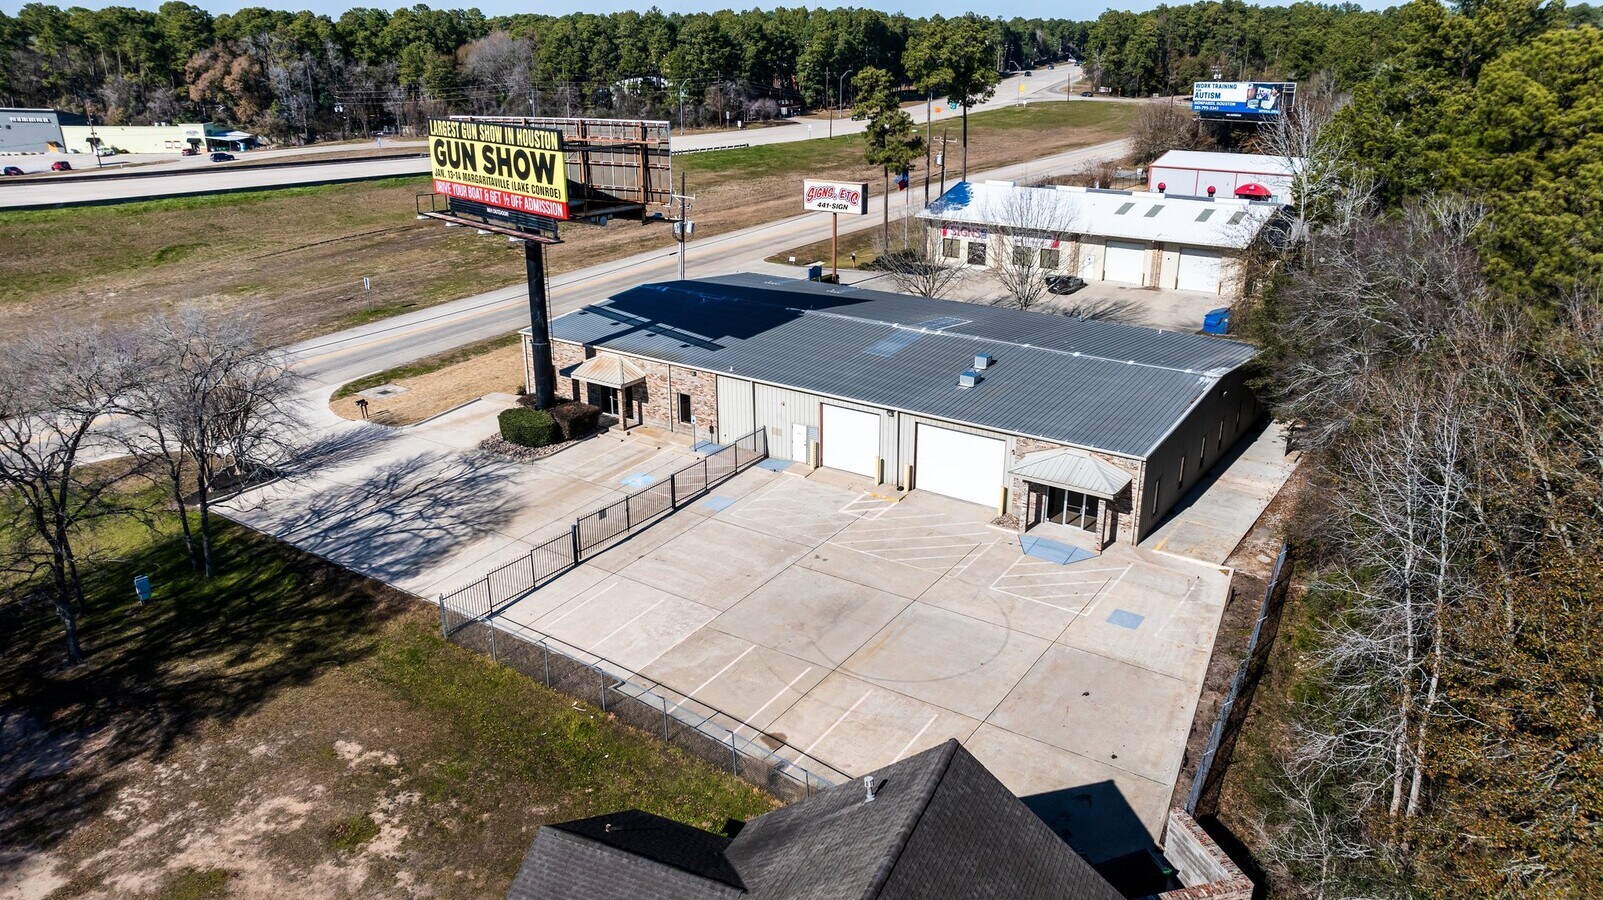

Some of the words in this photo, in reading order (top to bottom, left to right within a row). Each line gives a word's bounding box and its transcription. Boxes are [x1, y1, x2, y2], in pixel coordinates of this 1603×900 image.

[429, 120, 459, 138] LARGEST
[461, 122, 477, 140] GUN
[479, 124, 502, 143] SHOW
[504, 126, 515, 145] IN
[516, 128, 559, 150] HOUSTON
[433, 138, 477, 172] GUN
[482, 144, 556, 185] SHOW
[435, 168, 446, 178] JAN.
[448, 170, 461, 180] 13-14
[462, 172, 510, 189] MARGARITAVILLE
[511, 181, 530, 193] (LAKE
[531, 184, 561, 200] CONROE)
[435, 180, 452, 194] DRIVE
[452, 183, 467, 198] YOUR
[468, 186, 483, 200] BOAT
[484, 189, 489, 201] &
[490, 190, 502, 204] GET
[510, 194, 523, 208] OFF
[524, 196, 563, 217] ADMISSION
[817, 202, 849, 210] 441-SIGN
